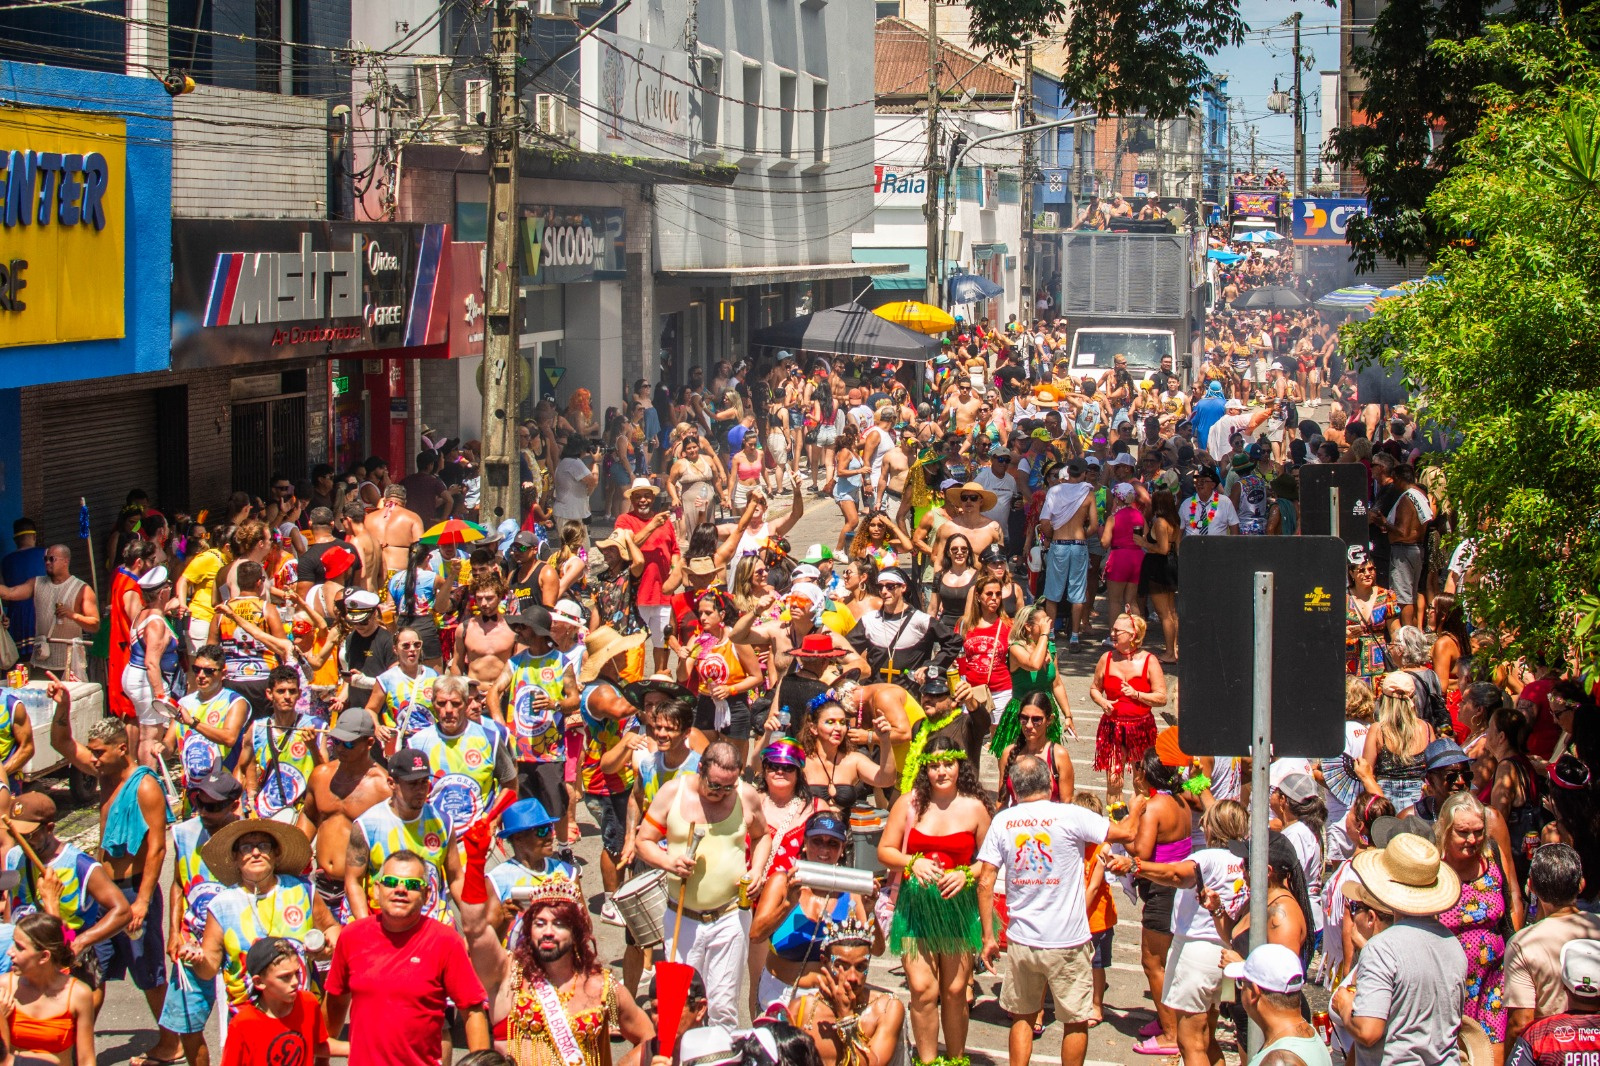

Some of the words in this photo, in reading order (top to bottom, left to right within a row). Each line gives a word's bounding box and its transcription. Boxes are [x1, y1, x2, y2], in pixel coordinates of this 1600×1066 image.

[883, 173, 925, 194] Raia
[545, 226, 593, 267] SICOOB
[374, 305, 401, 326] GREE
[271, 328, 288, 347] Ar
[1006, 818, 1038, 830] BLOCO
[1011, 877, 1043, 887] CARNAVAL
[1045, 877, 1060, 886] 2025
[545, 1001, 556, 1017] DA
[549, 1017, 575, 1060] BATERIA
[1578, 1034, 1596, 1042] livre
